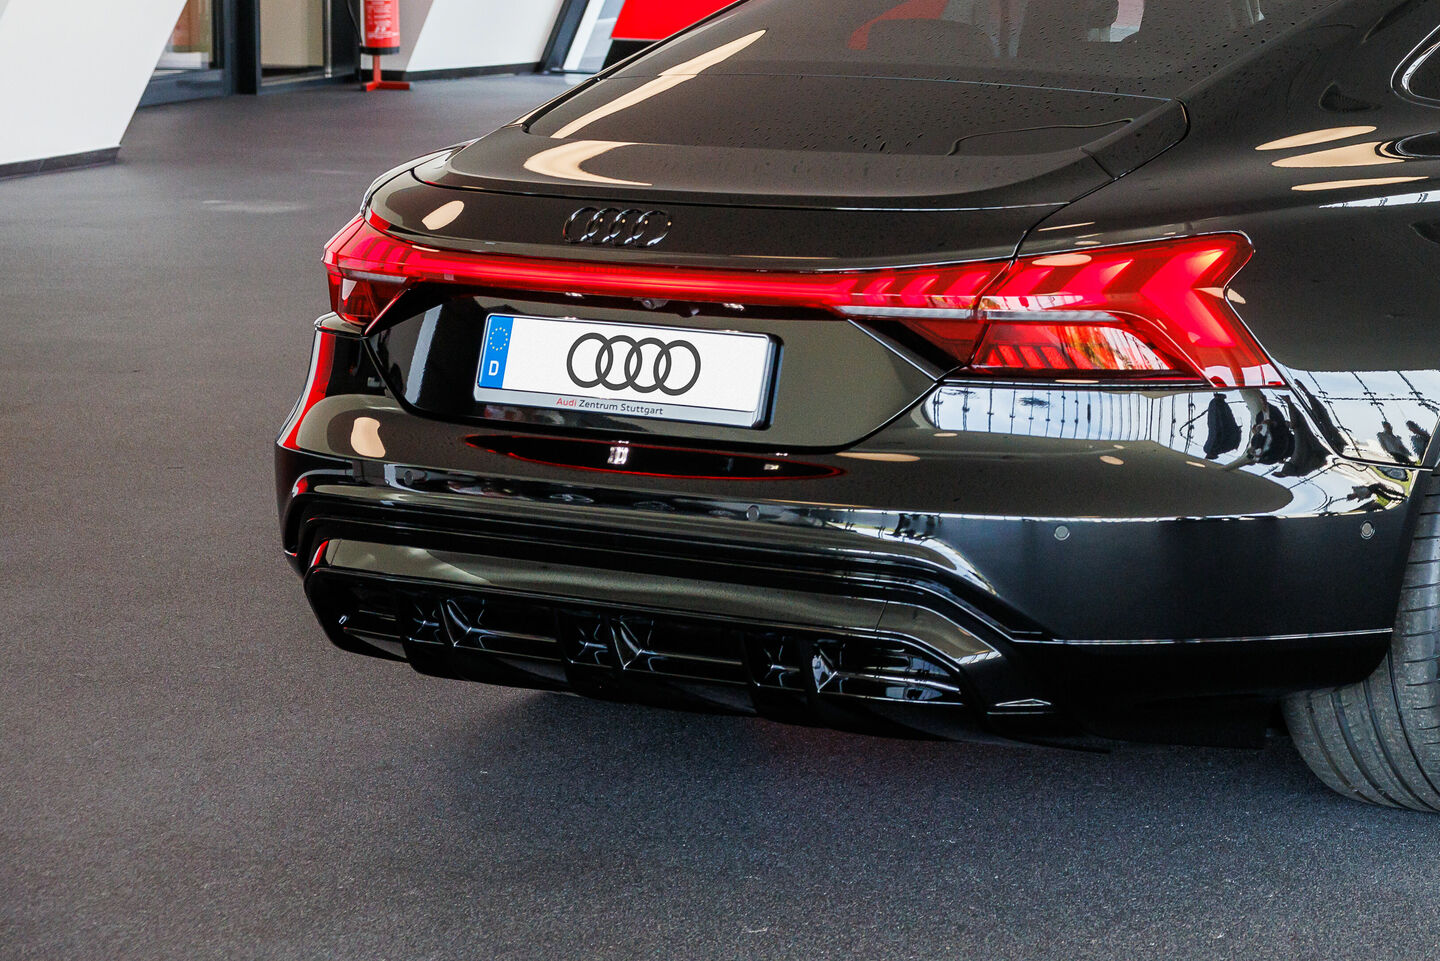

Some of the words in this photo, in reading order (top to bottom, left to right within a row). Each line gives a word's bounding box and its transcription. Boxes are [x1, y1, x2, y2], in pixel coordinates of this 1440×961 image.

[488, 360, 499, 376] D
[556, 397, 577, 407] Audi
[579, 400, 618, 411] Zentrum
[620, 403, 663, 415] Stuttgart
